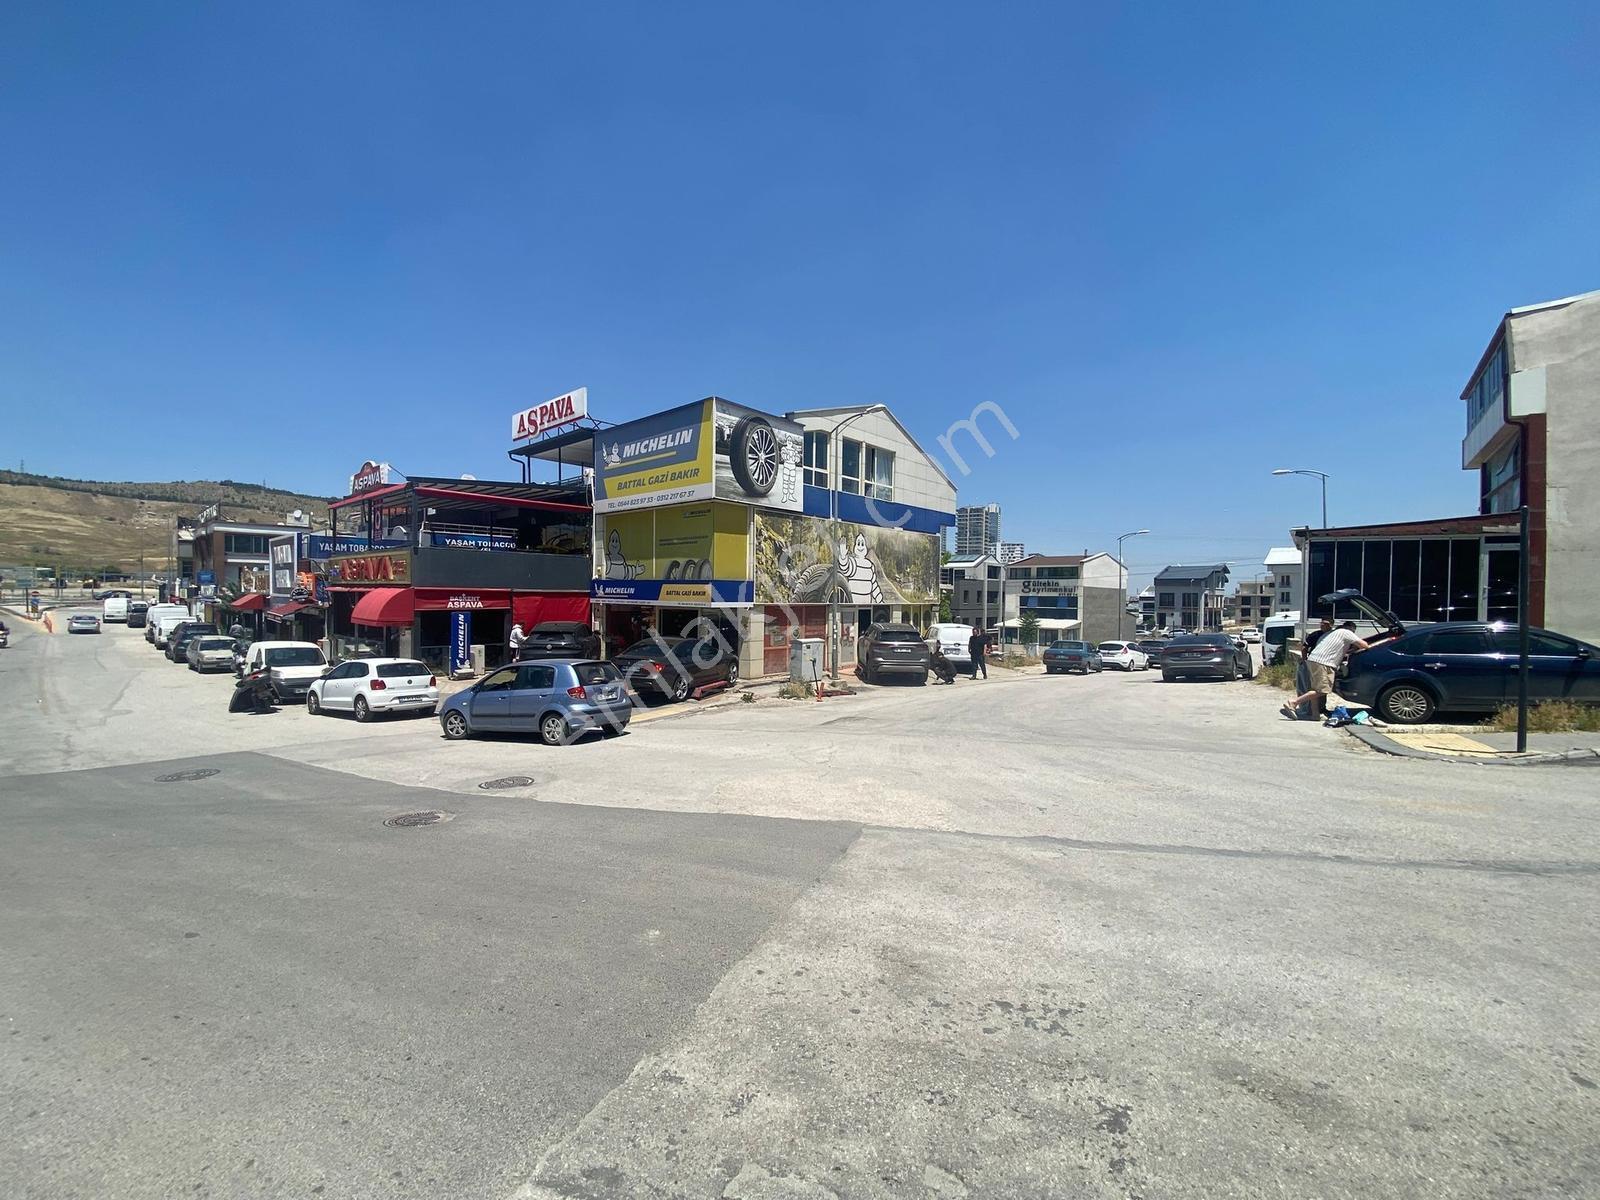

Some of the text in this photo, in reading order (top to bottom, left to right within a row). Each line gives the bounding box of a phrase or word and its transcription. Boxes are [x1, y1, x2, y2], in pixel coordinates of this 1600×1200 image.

[517, 395, 575, 436] ASPAVA
[623, 429, 693, 458] MICHELIN
[353, 470, 381, 491] ASPAVA
[617, 468, 700, 491] BATTAL GAZİ BAKIR
[341, 556, 394, 581] ASPAVA
[604, 586, 635, 595] MICHELIN
[447, 601, 484, 609] ASPAVA
[457, 613, 465, 659] MICHELIN
